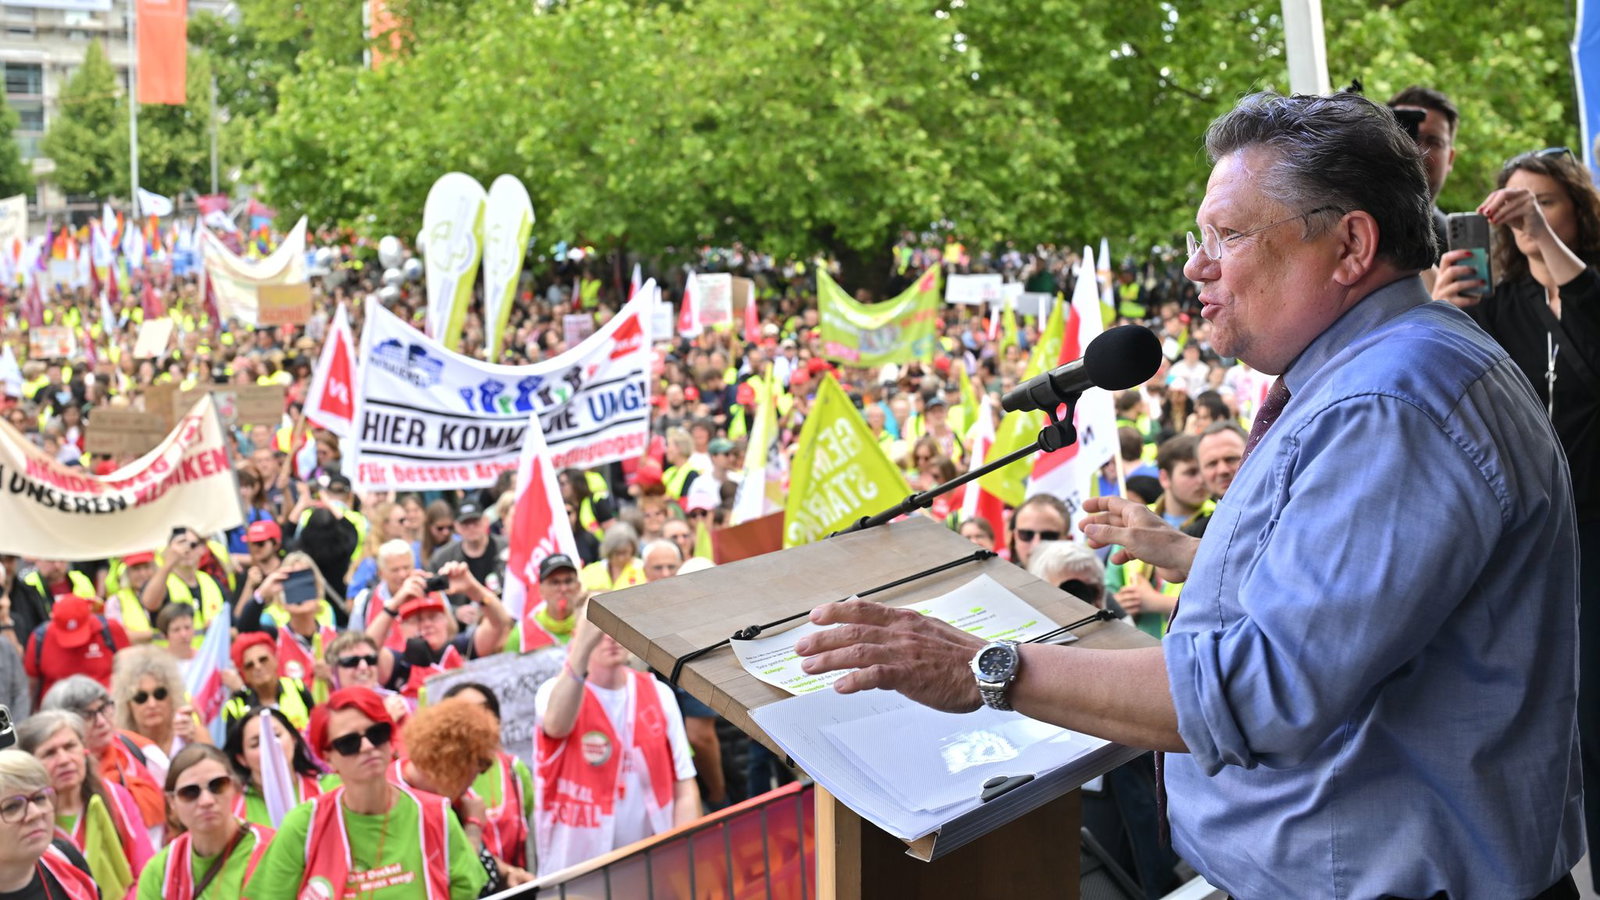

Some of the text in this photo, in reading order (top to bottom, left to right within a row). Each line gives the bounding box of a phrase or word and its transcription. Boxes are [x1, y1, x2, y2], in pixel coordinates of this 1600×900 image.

[362, 411, 425, 447] HIER
[438, 422, 527, 452] KOMM
[9, 471, 127, 514] UNSEREN
